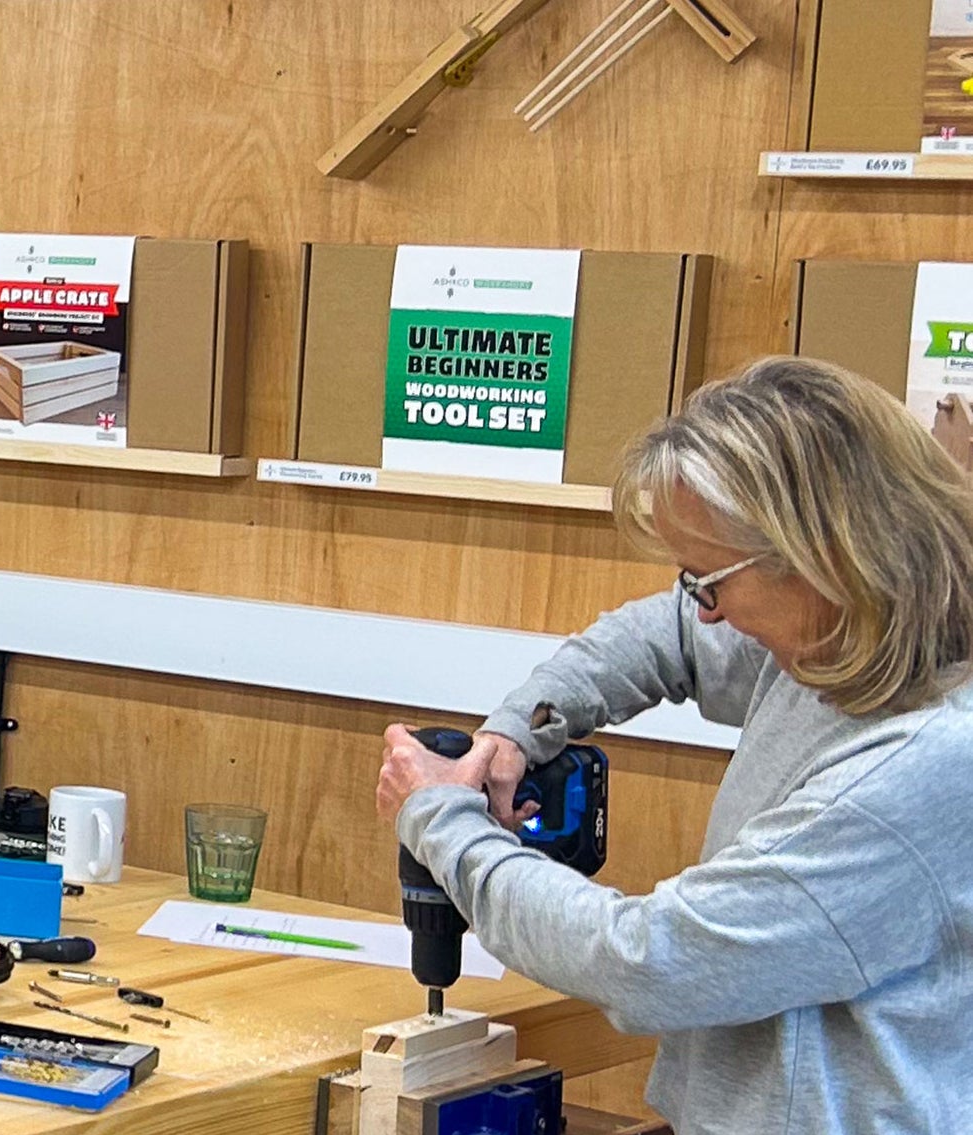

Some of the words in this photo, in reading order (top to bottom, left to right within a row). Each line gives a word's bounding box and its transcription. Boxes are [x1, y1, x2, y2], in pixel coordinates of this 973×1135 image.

[865, 159, 907, 171] £69.95
[0, 287, 53, 305] APPLE
[55, 289, 109, 307] CRATE
[408, 325, 552, 357] ULTIMATE
[407, 354, 549, 382] BEGINNERS
[405, 381, 547, 405] WOODWORKING
[404, 400, 485, 428] TOOL
[488, 406, 547, 432] SET
